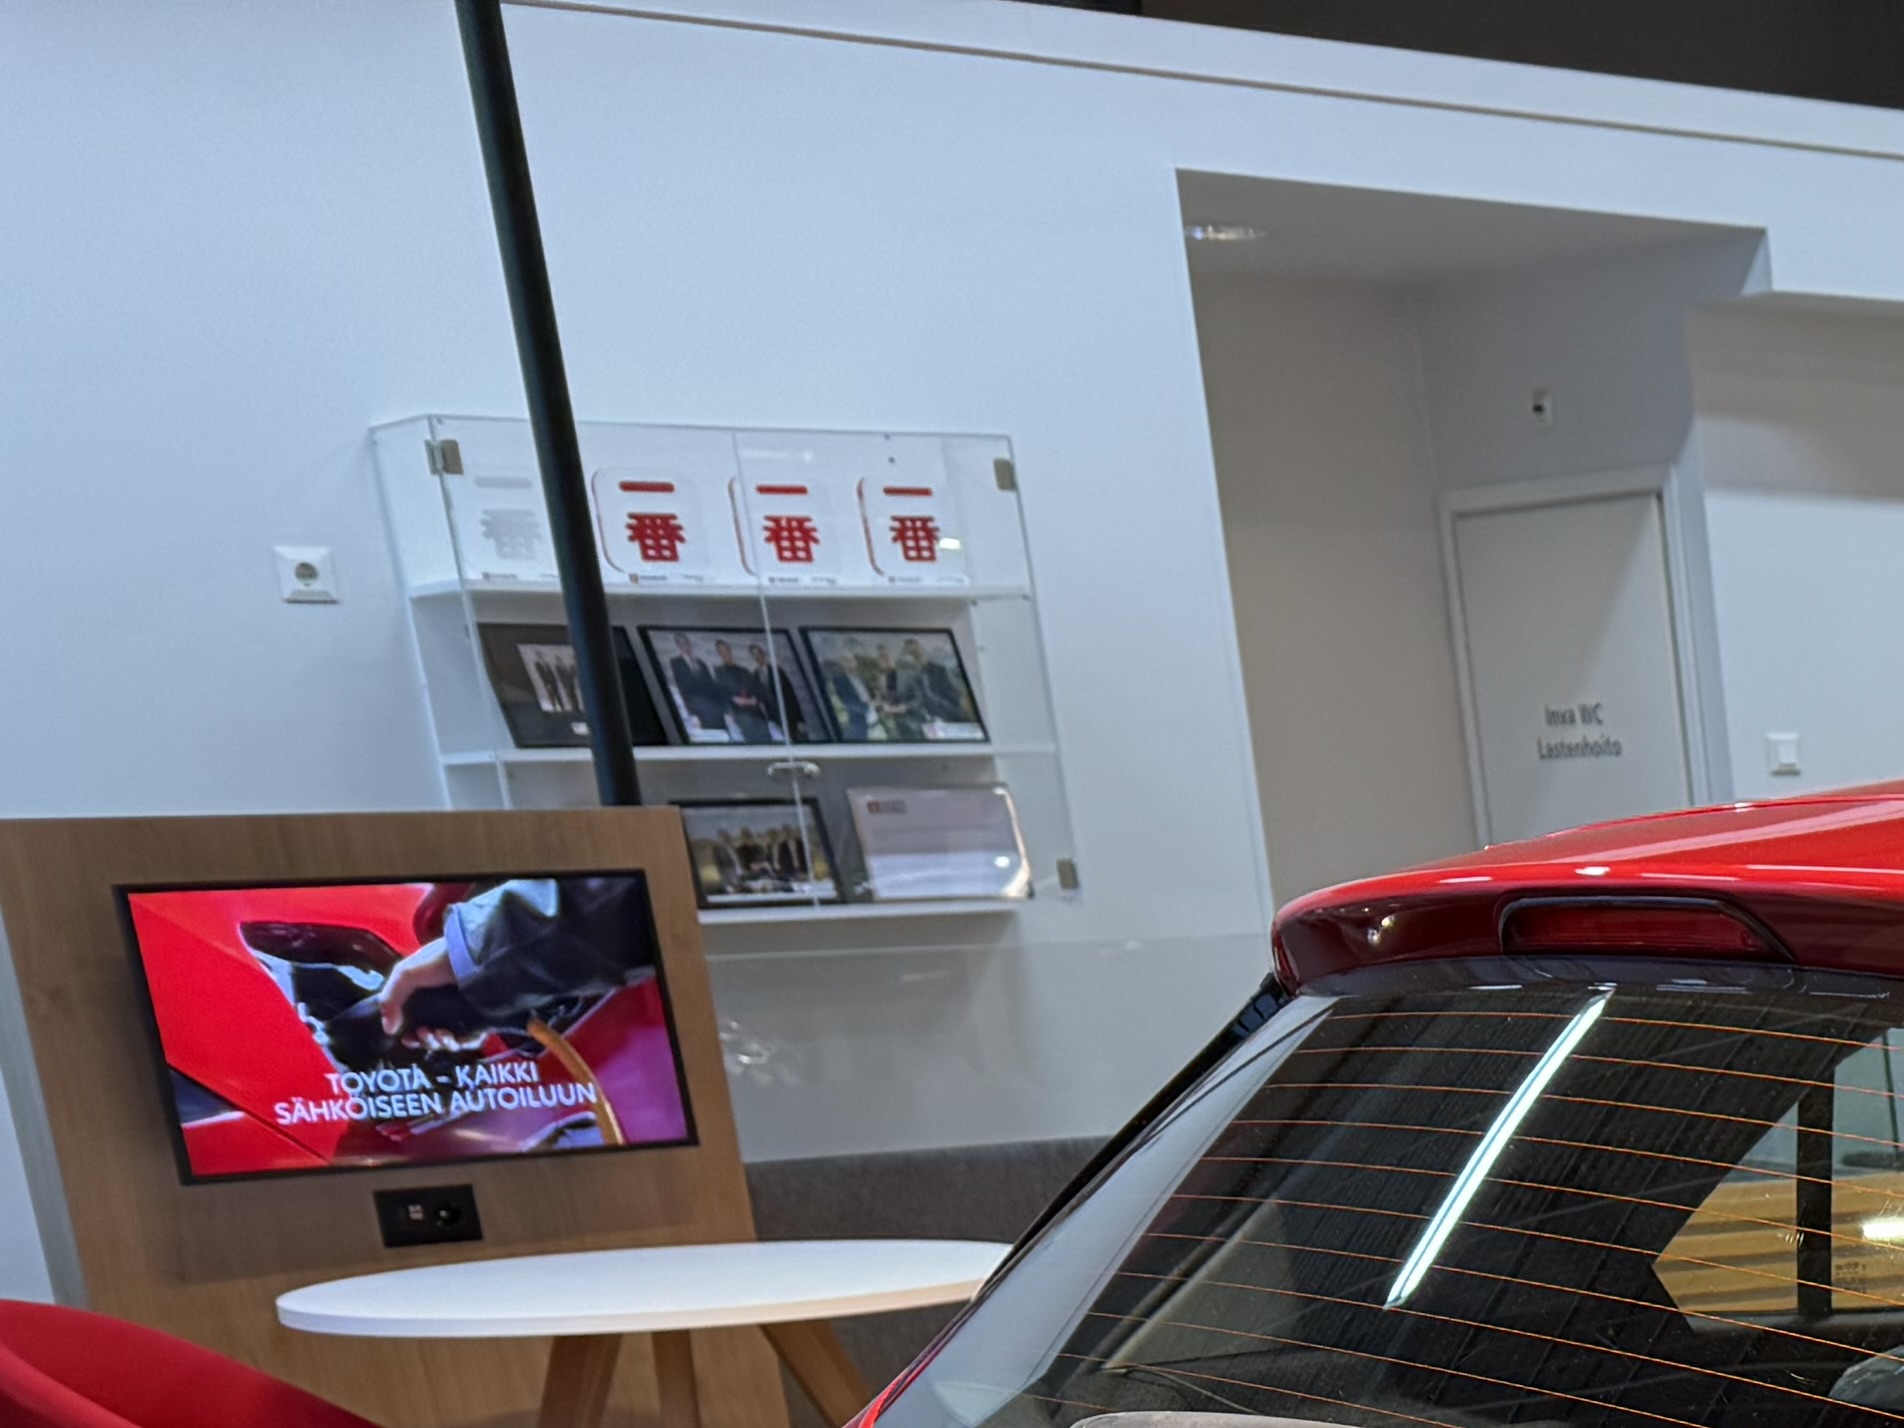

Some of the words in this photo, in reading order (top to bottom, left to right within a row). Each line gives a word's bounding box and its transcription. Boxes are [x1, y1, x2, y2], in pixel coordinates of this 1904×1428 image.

[1537, 734, 1623, 760] Lastenhoito
[325, 1063, 432, 1095] TOYOTA
[455, 1060, 540, 1089] KAIKKI
[274, 1090, 443, 1126] SÄHKÖISEEN
[450, 1082, 598, 1114] AUTOILUUN
